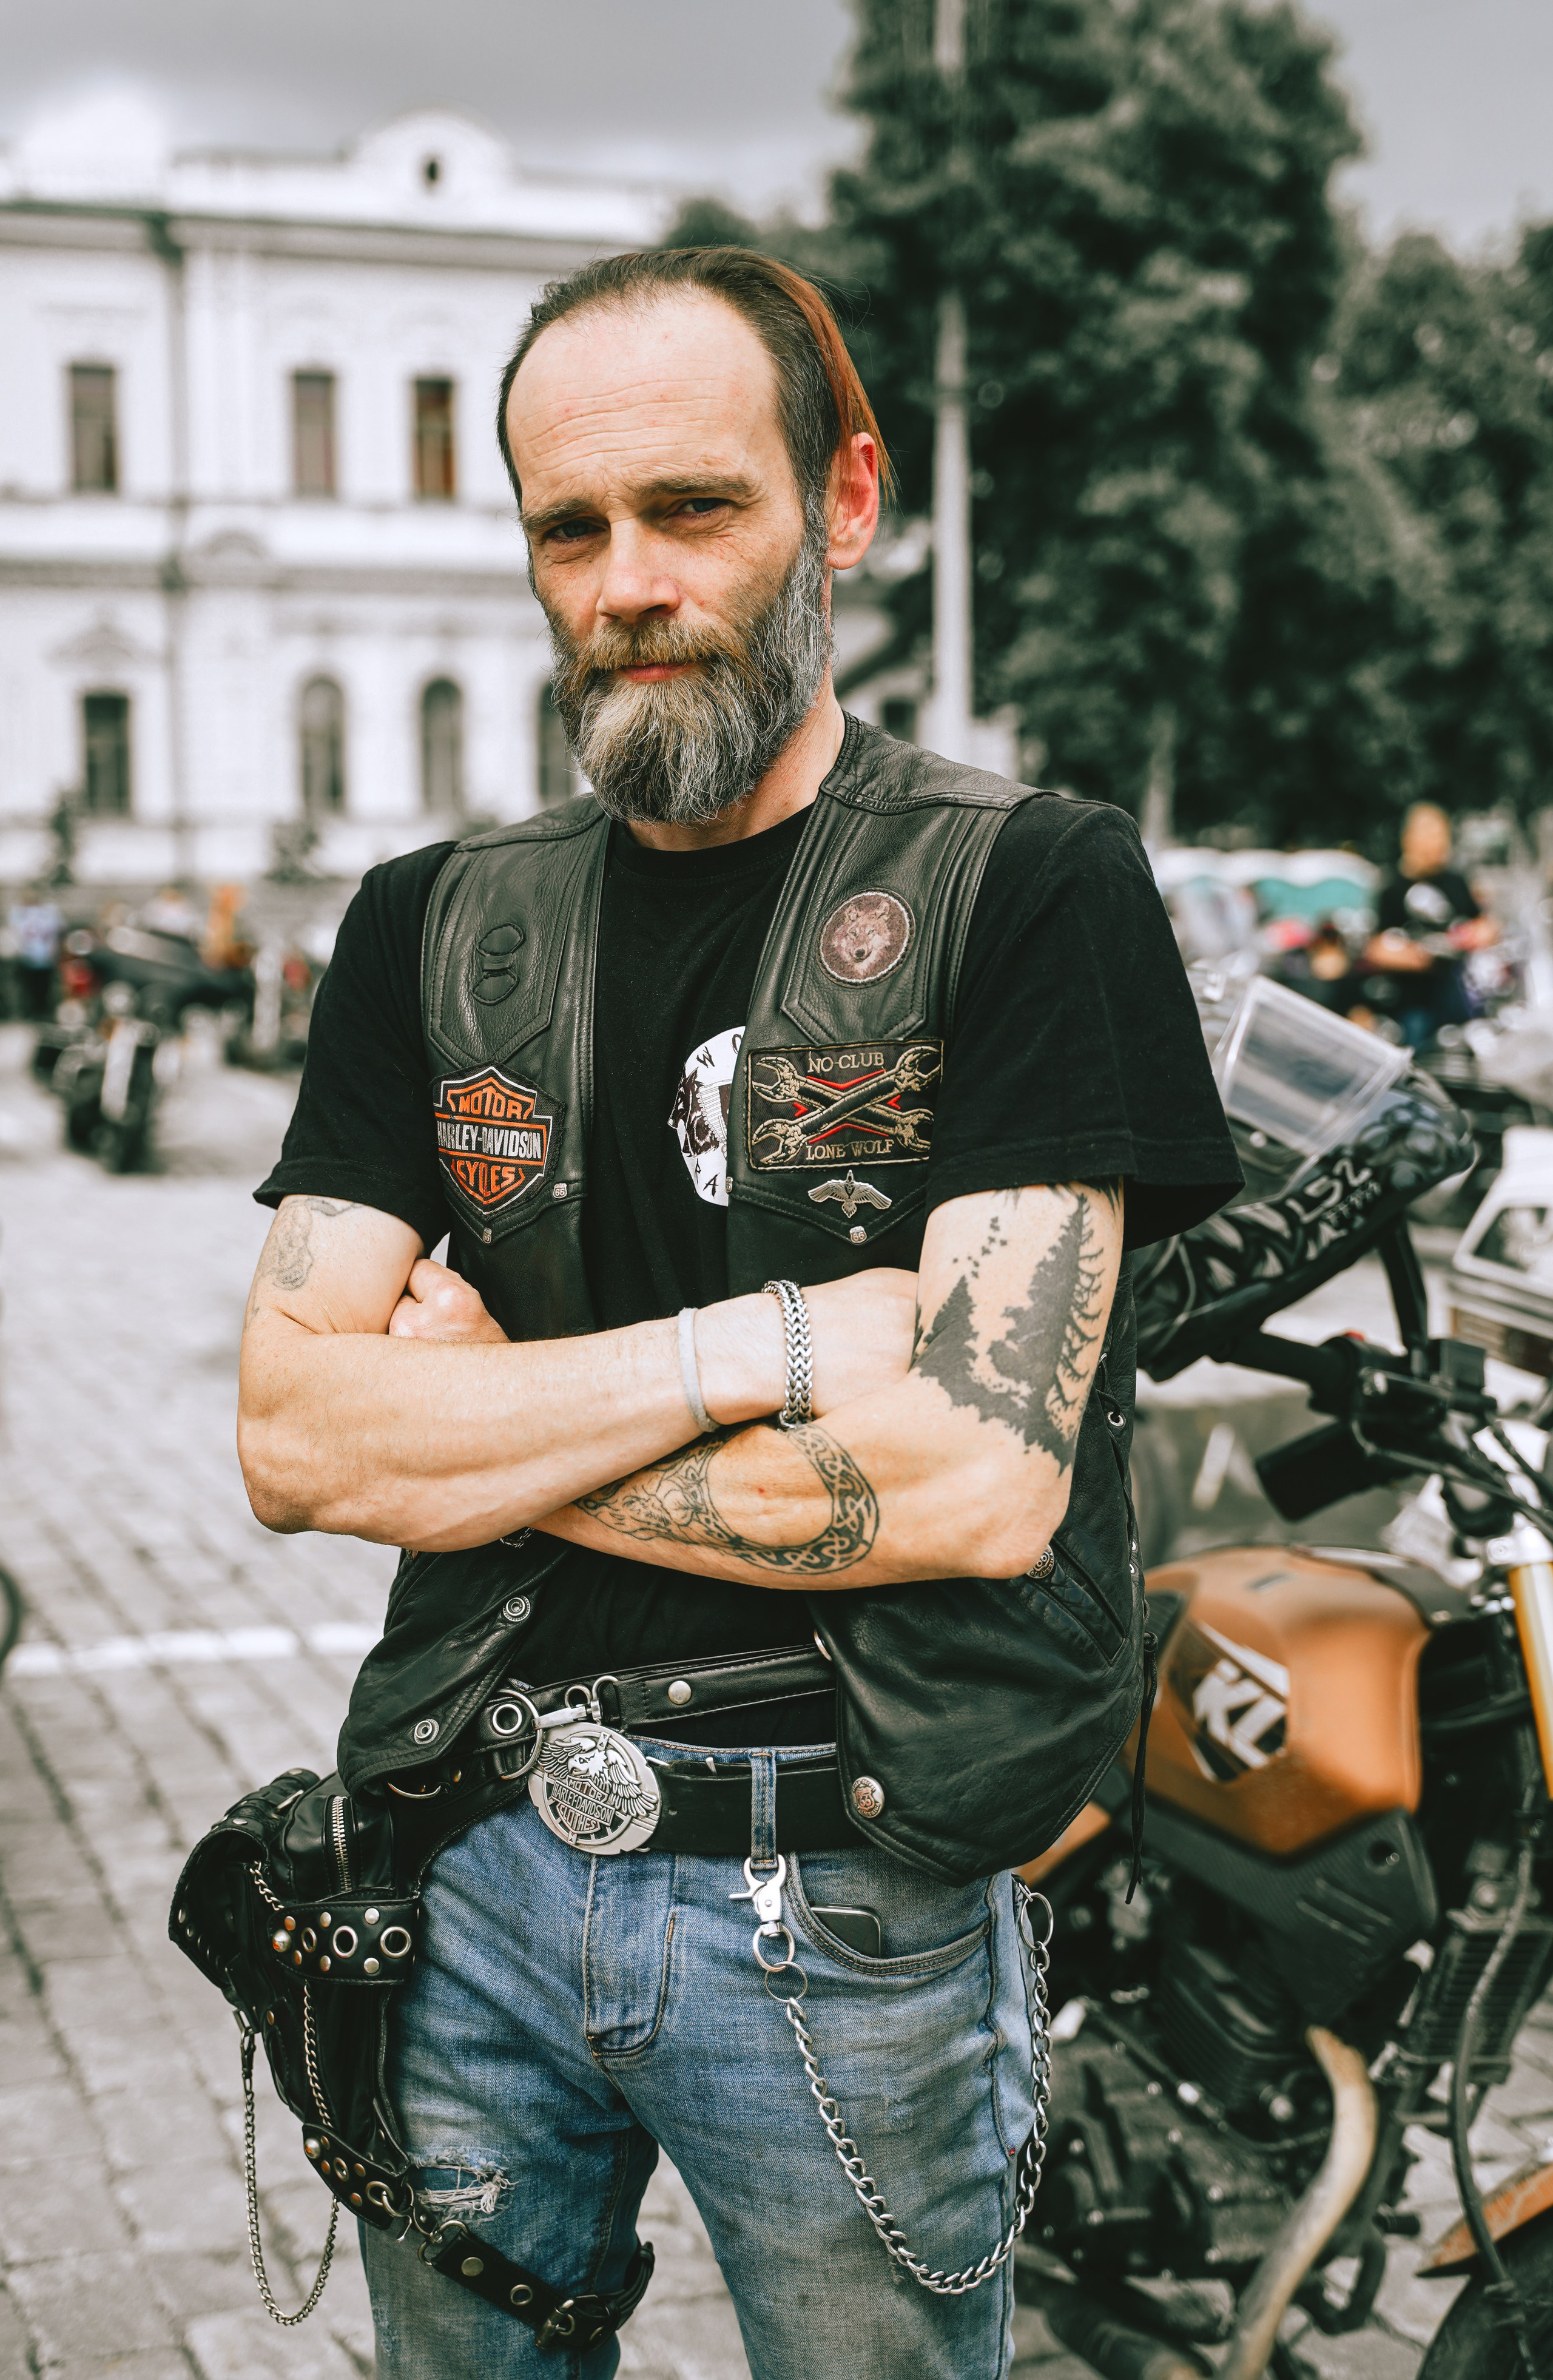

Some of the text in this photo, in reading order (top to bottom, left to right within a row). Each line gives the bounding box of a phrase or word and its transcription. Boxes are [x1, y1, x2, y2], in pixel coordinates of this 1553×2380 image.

[807, 1052, 884, 1073] NO-CLUB
[459, 1086, 522, 1120] MOTOR
[437, 1121, 542, 1159] HARLEY-DAVIDSON
[806, 1139, 894, 1161] LONE WOLF
[554, 1188, 565, 1196] 66
[853, 1232, 865, 1242] 66
[568, 1779, 603, 1801] MOTOR
[860, 1795, 872, 1807] 66
[553, 1783, 613, 1823] HARLEY-DAVIDSON
[559, 1804, 597, 1831] CLOTHES
